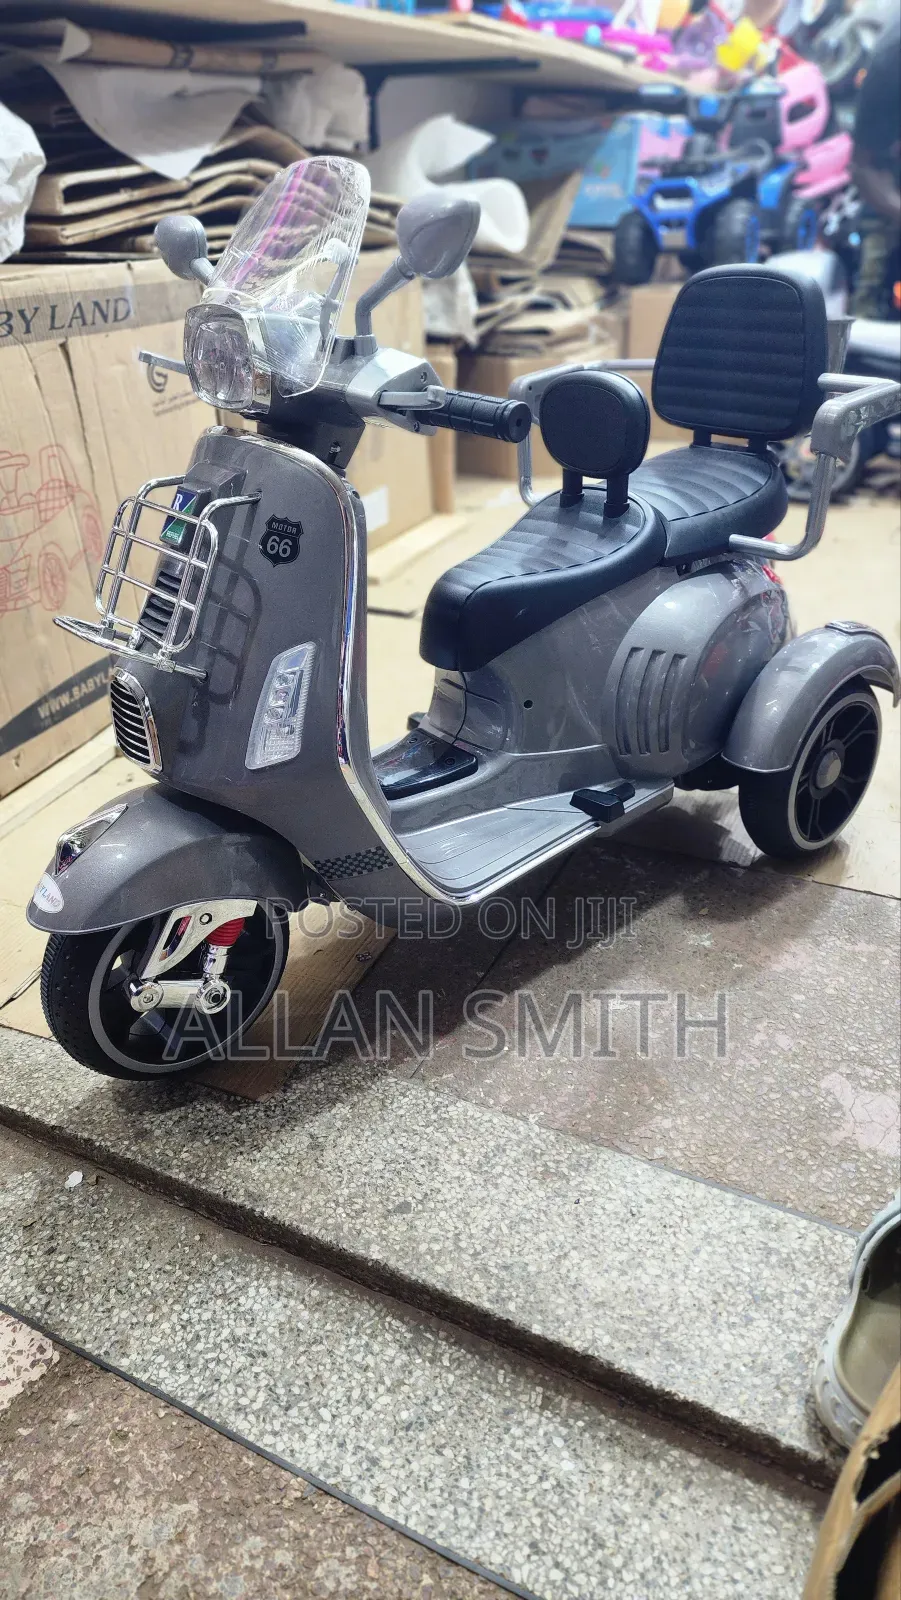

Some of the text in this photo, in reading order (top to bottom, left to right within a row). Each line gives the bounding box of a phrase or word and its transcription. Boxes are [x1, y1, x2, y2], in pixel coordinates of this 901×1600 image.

[49, 297, 131, 331] LAND
[173, 493, 183, 511] R
[271, 521, 297, 535] MOTOR
[267, 535, 293, 558] 66
